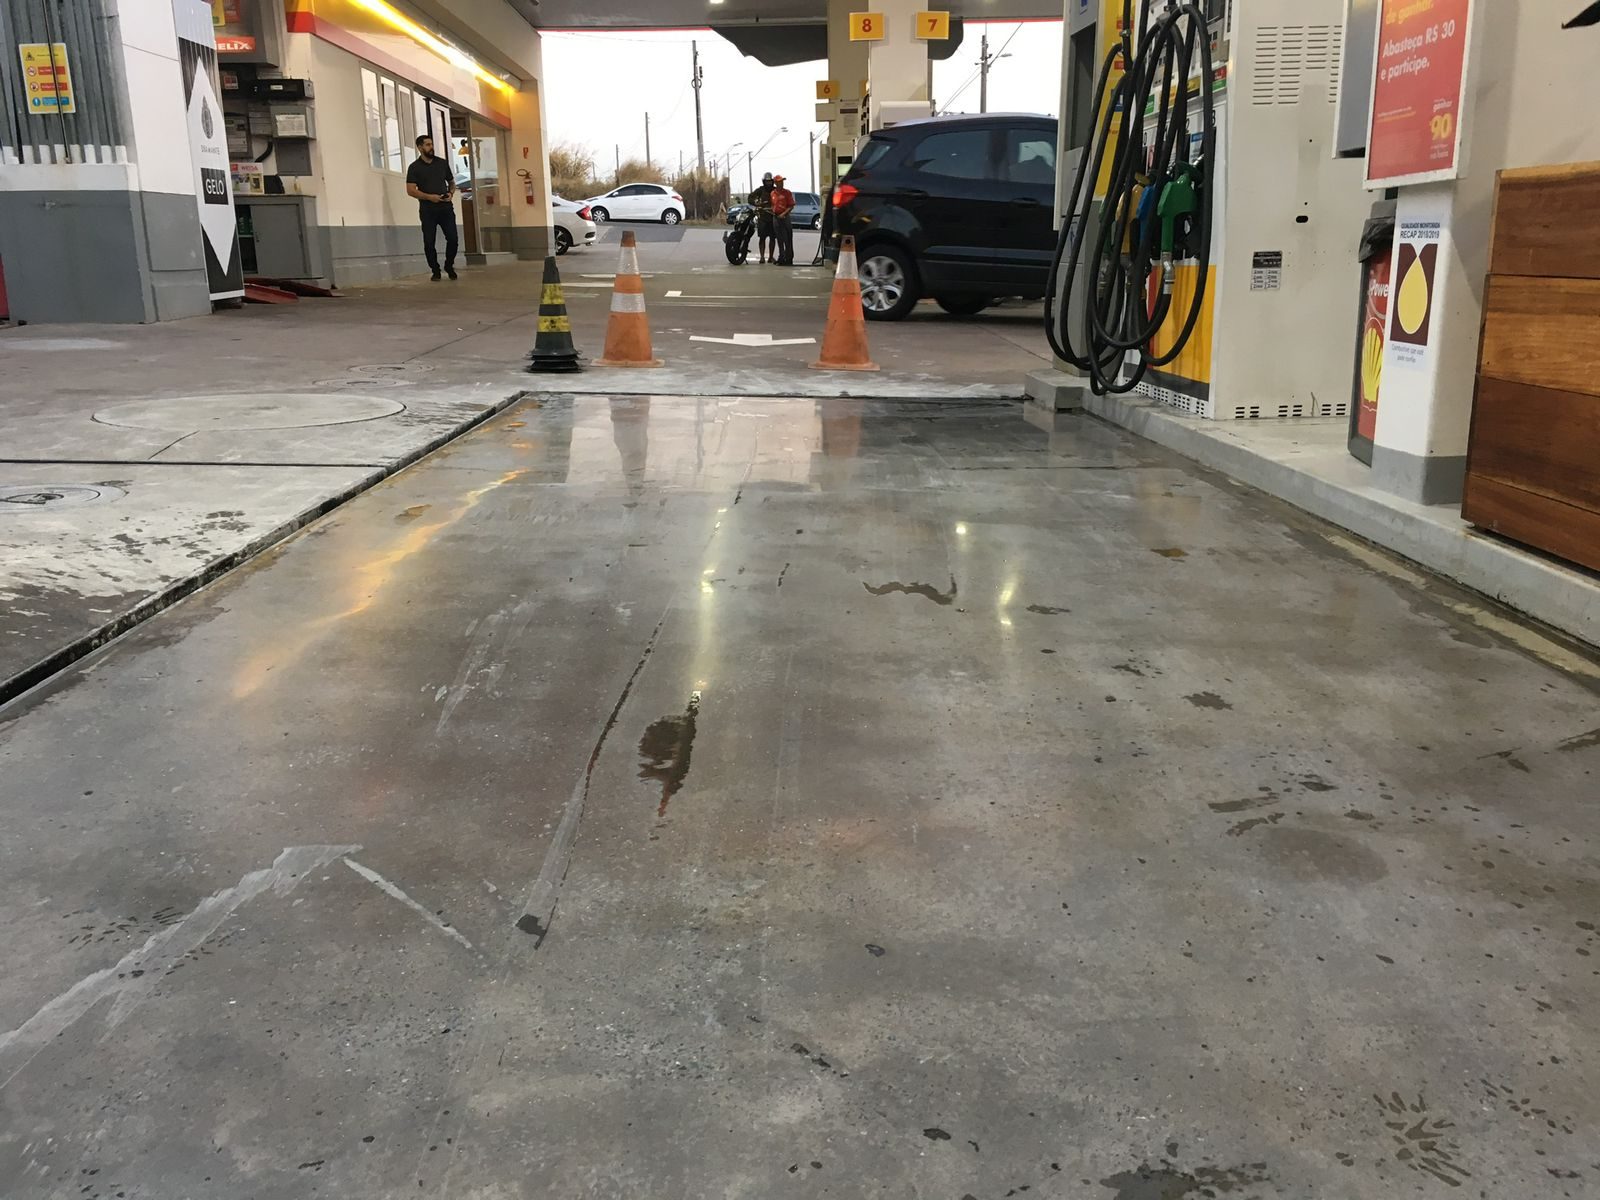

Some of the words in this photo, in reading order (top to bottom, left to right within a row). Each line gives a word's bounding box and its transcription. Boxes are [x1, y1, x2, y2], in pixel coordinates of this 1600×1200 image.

[862, 18, 872, 33] 8
[928, 18, 938, 32] 7
[1382, 34, 1423, 58] Abasteça
[1425, 25, 1439, 44] R$
[1441, 19, 1456, 38] 30
[1380, 68, 1387, 80] e
[1388, 54, 1430, 82] participe.
[823, 84, 831, 94] 6
[1430, 113, 1452, 140] 90
[205, 178, 226, 195] GELO
[1400, 230, 1417, 239] RECAP
